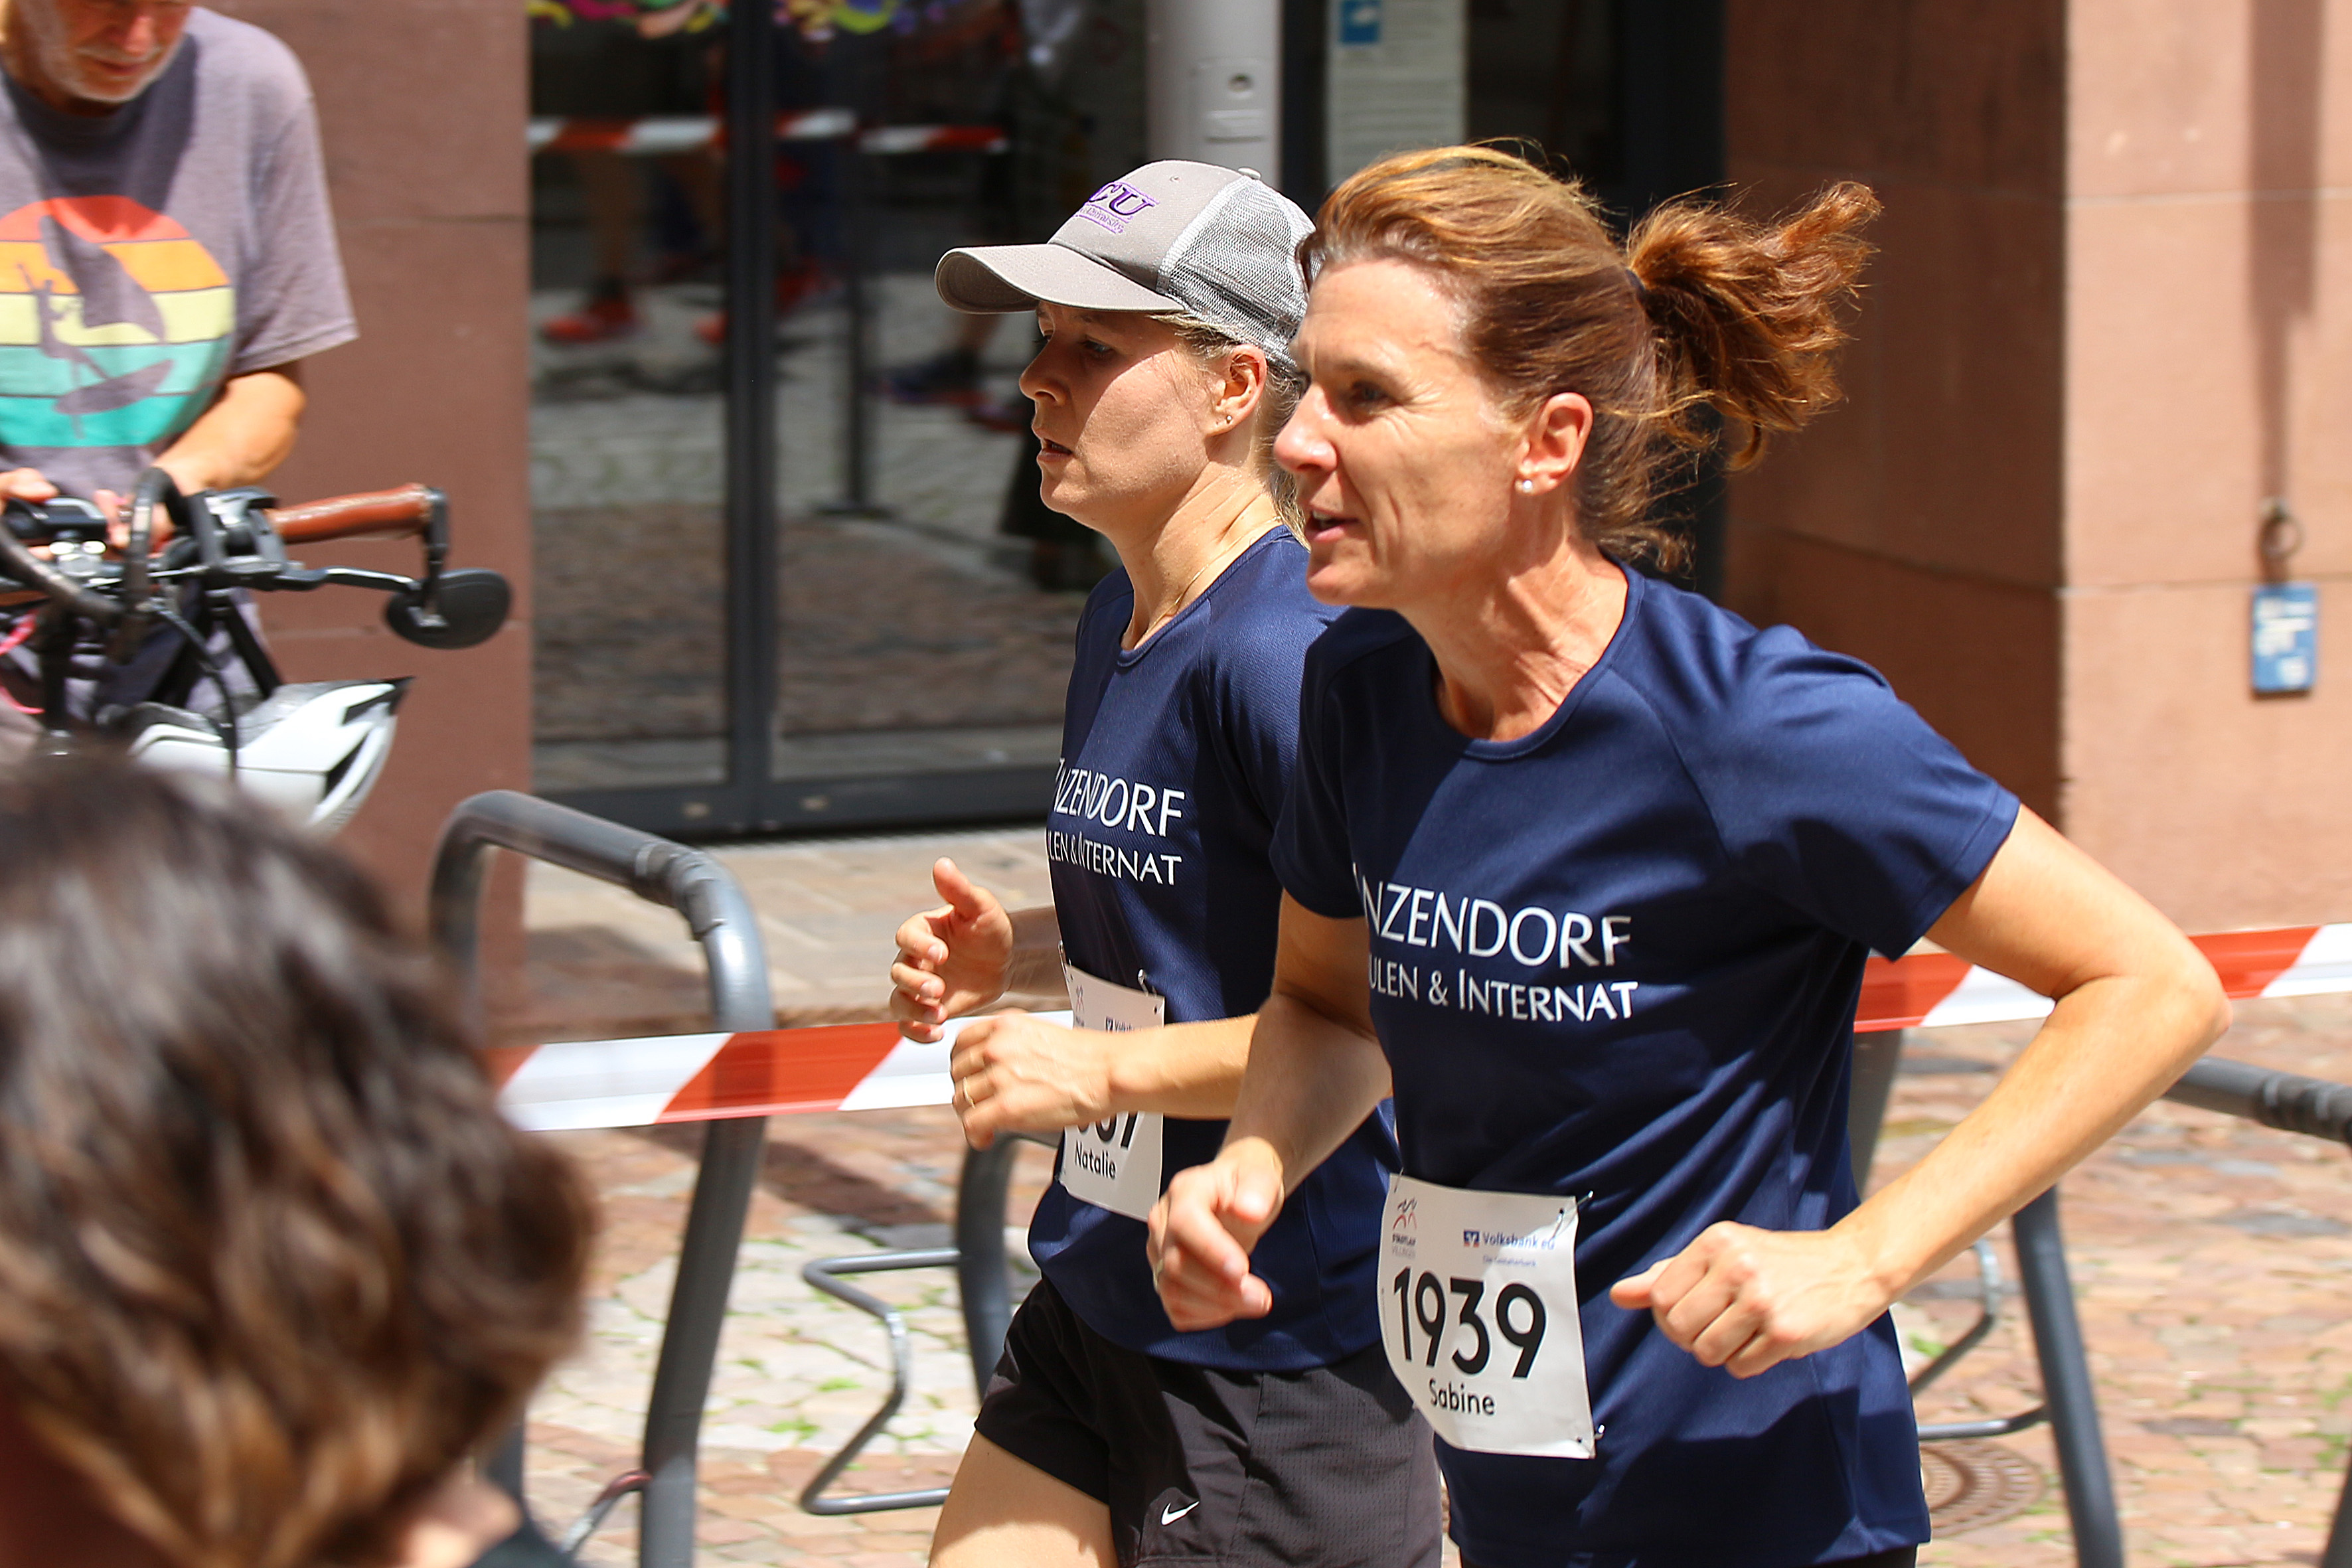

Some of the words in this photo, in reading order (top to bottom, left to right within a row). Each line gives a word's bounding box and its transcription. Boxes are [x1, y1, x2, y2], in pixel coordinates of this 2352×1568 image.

[1070, 834, 1079, 865] &
[1429, 970, 1449, 1007] &
[1075, 1139, 1117, 1180] Natalie
[1483, 1231, 1538, 1249] Volksbank
[1394, 1267, 1547, 1379] 1939
[1429, 1377, 1496, 1417] Sabine
